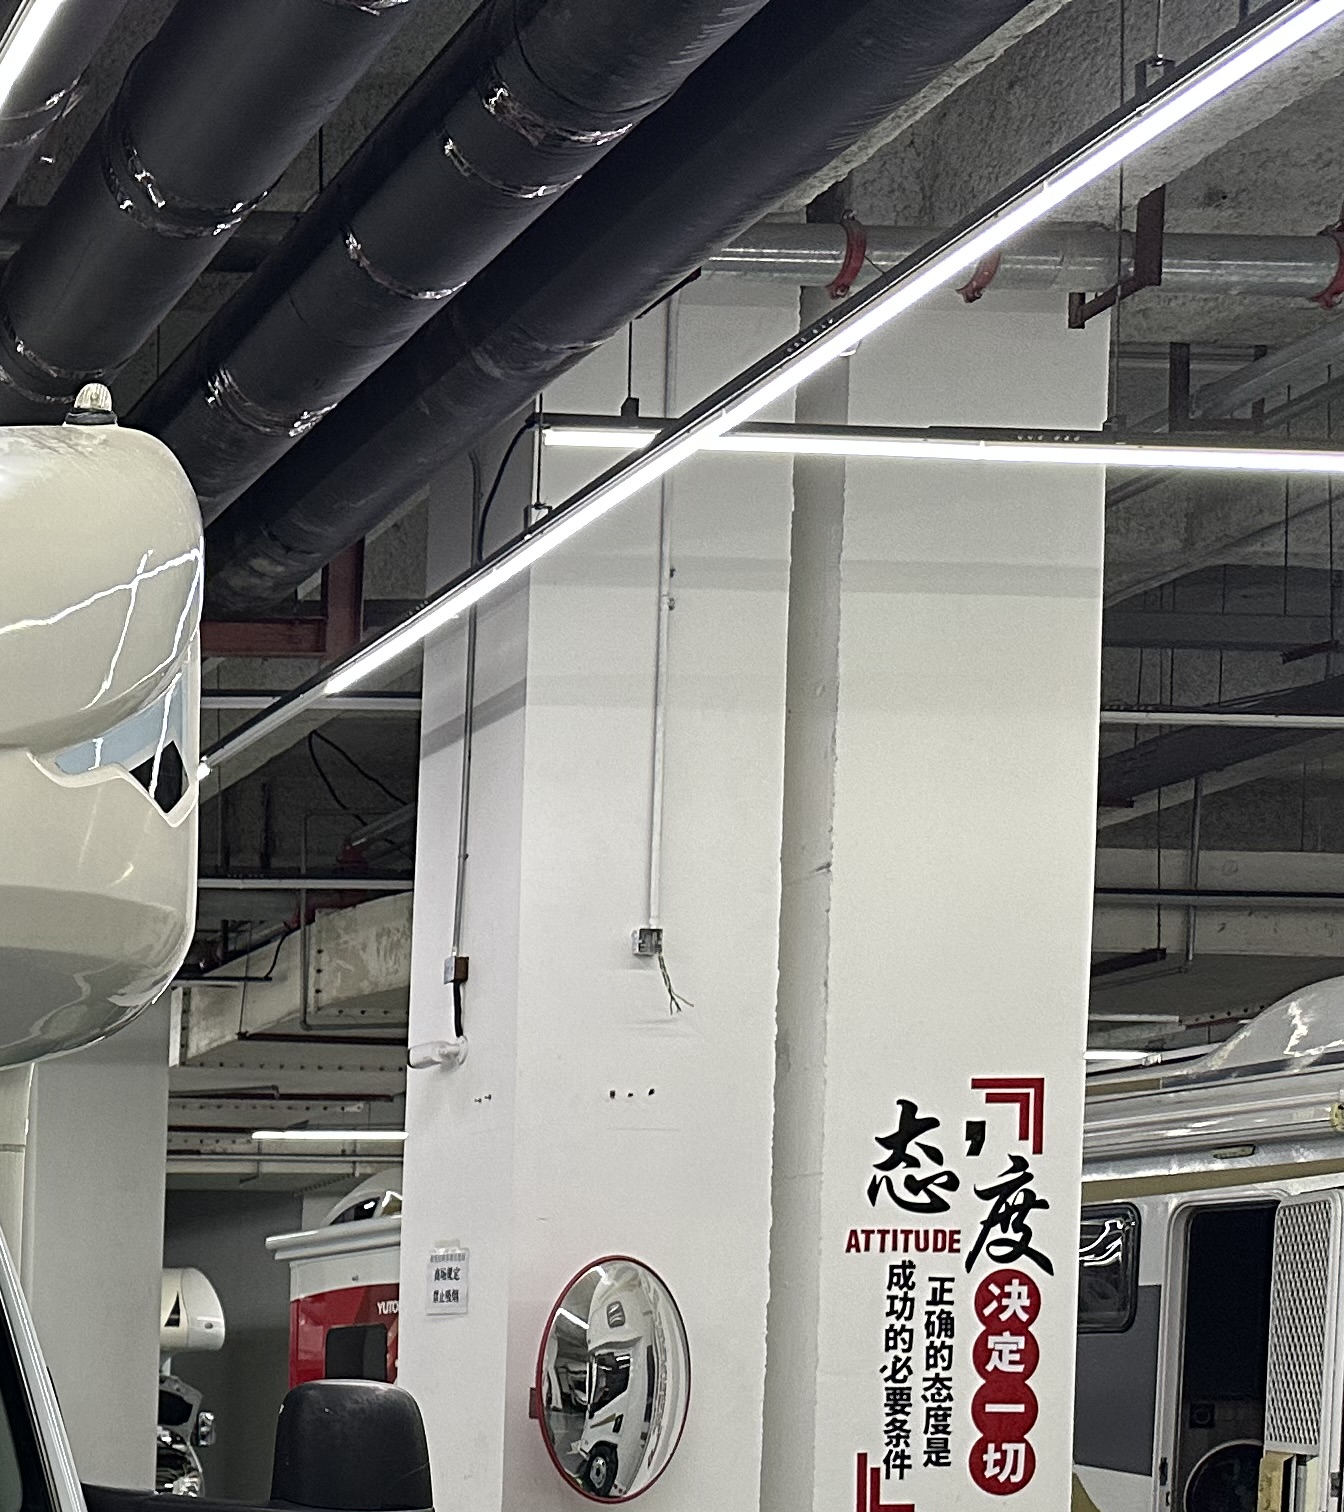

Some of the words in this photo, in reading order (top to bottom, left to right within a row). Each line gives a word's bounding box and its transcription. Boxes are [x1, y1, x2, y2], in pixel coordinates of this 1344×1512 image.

[845, 1228, 962, 1255] ATTITUDE
[879, 1260, 918, 1481] 成功的必要条件
[921, 1276, 956, 1469] 正确的态度是
[981, 1278, 1032, 1485] 决定一切
